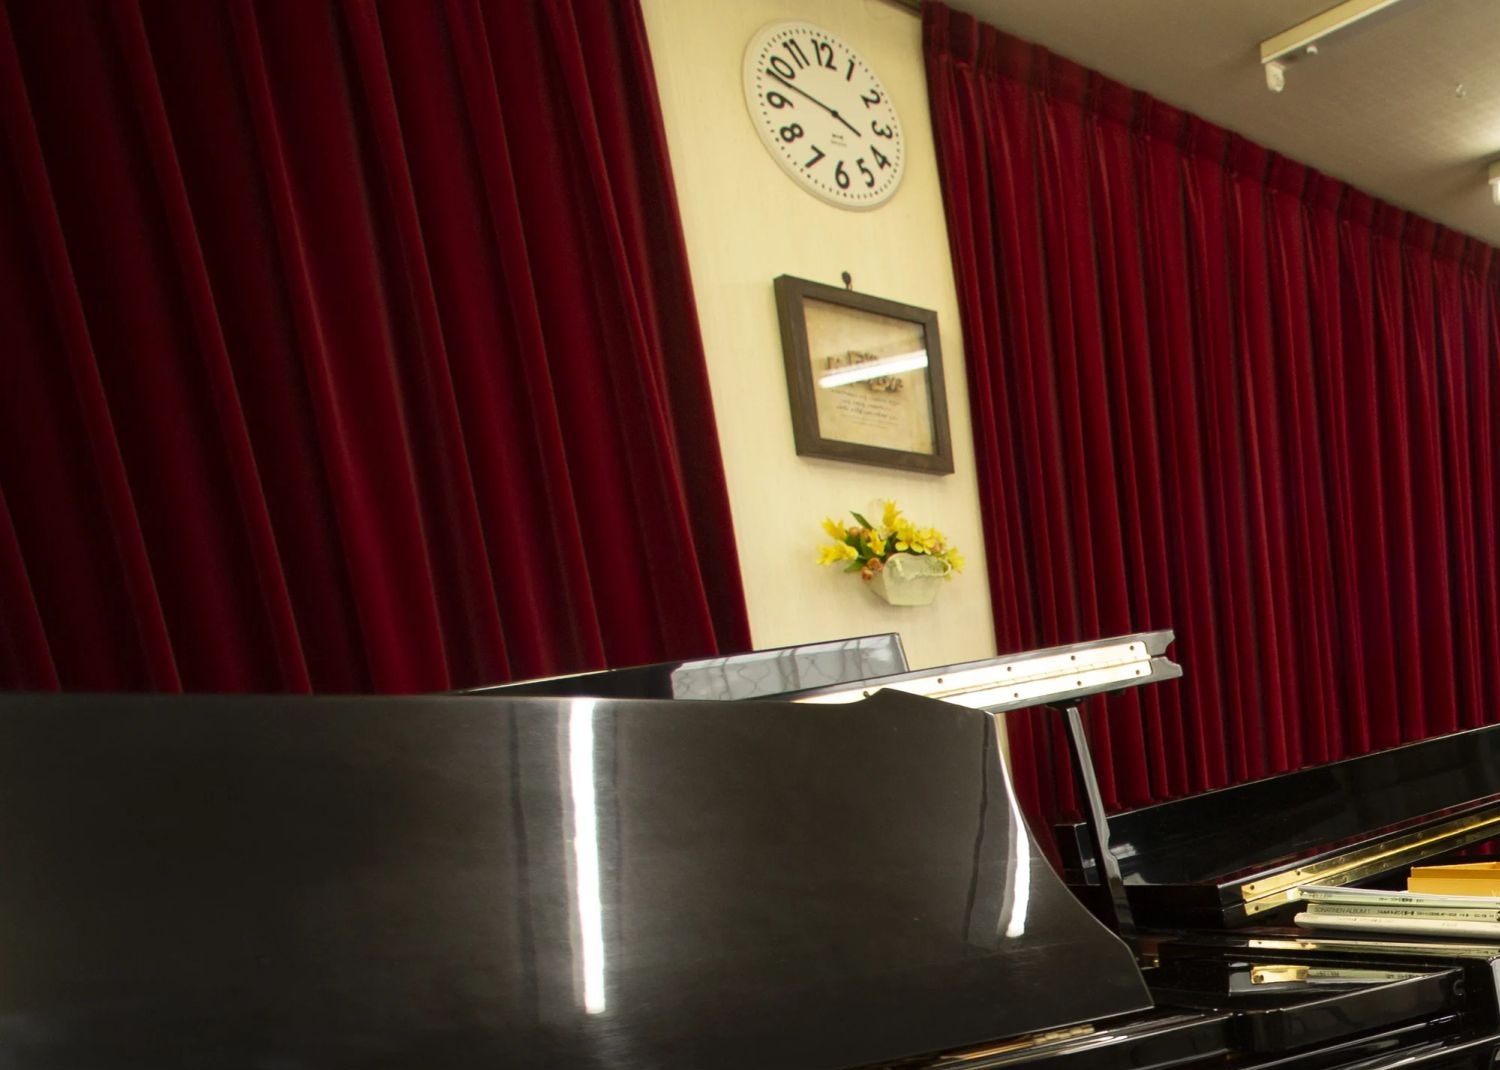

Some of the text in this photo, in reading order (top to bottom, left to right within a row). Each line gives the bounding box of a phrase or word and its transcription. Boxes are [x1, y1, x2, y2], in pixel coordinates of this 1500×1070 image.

[782, 38, 810, 69] 11
[810, 38, 837, 71] 12
[845, 58, 856, 82] 1
[766, 90, 794, 109] 9
[860, 89, 881, 109] 2
[779, 123, 804, 143] 8
[871, 120, 893, 140] 3
[804, 144, 826, 169] 7
[870, 145, 891, 170] 4
[834, 160, 850, 189] 6
[856, 158, 875, 188] 5
